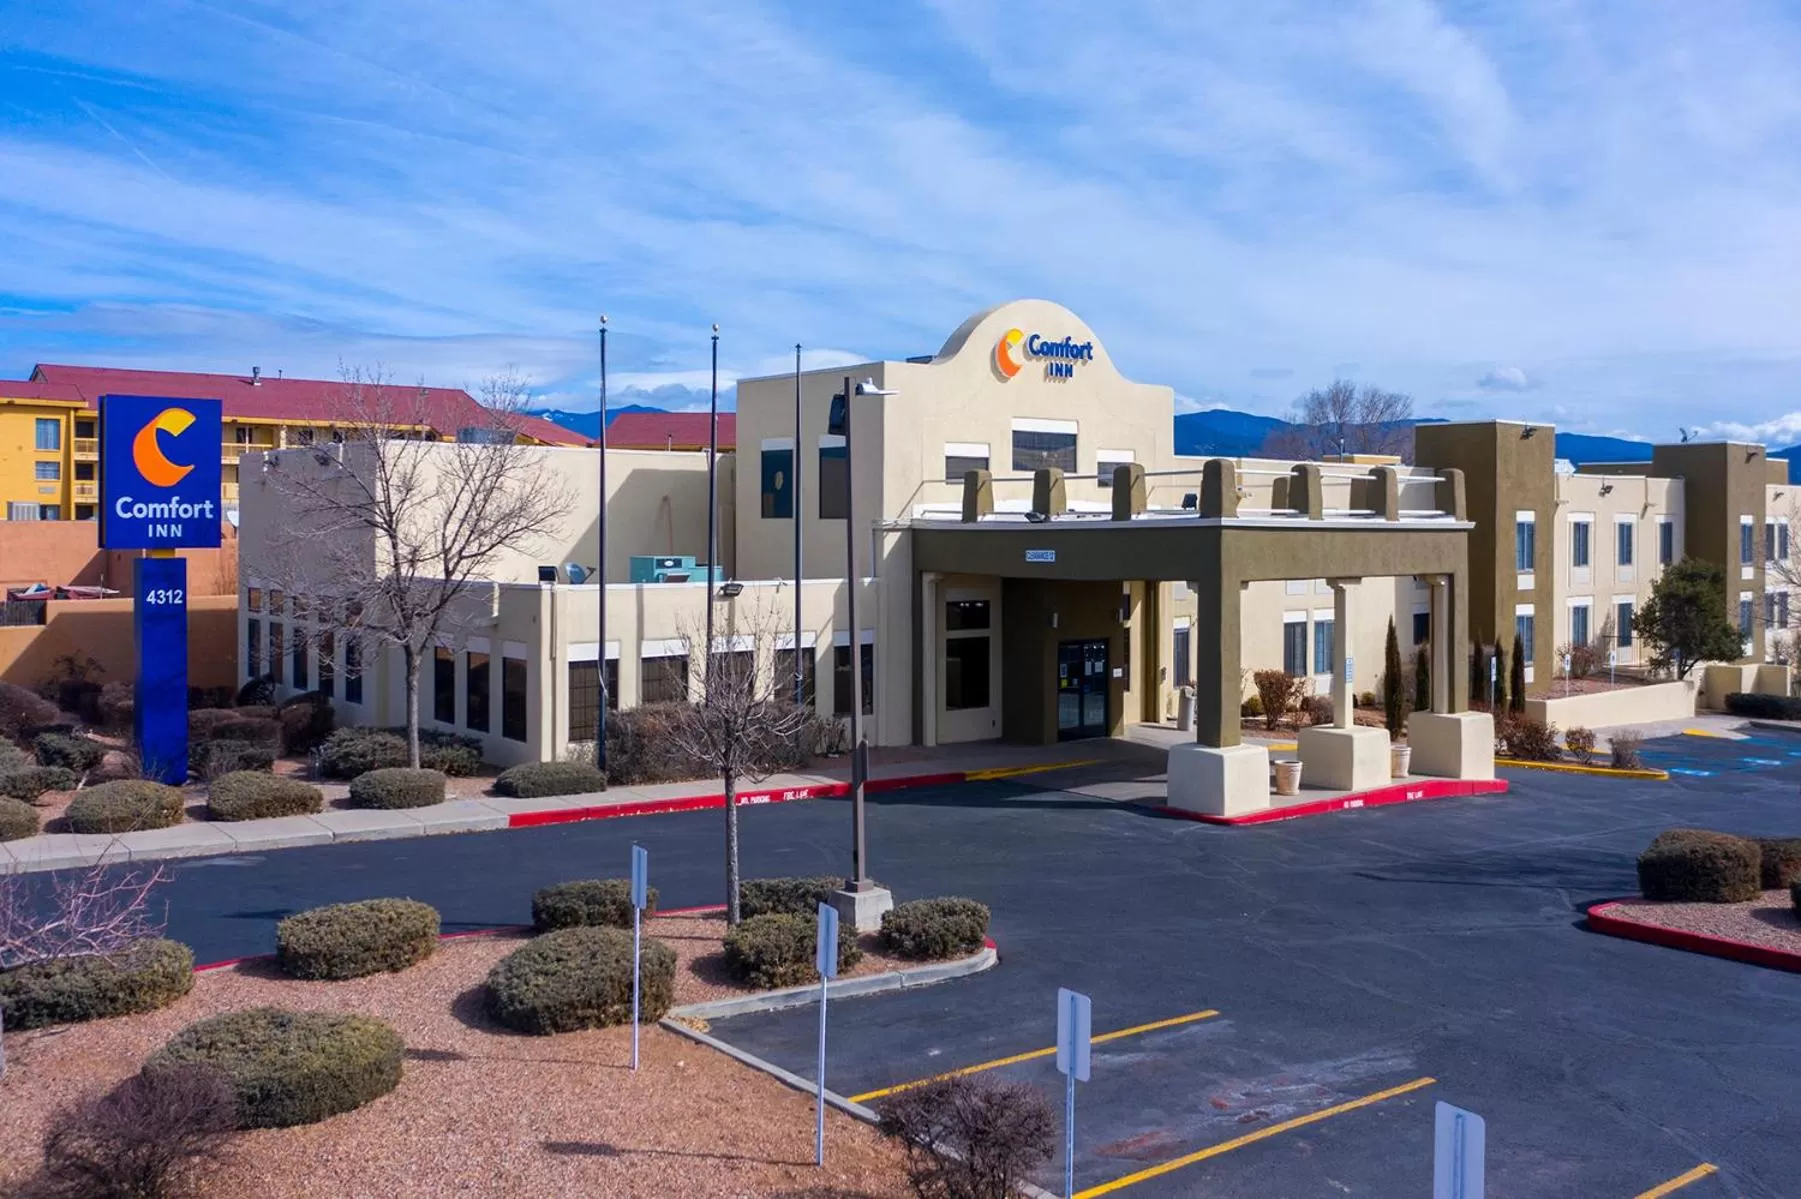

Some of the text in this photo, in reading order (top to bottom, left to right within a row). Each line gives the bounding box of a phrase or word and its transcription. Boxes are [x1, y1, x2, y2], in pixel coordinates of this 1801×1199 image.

[1027, 333, 1093, 360] Comfort
[1049, 361, 1073, 378] INN
[115, 496, 214, 519] Comfort
[148, 524, 182, 538] INN
[146, 590, 183, 605] 4312
